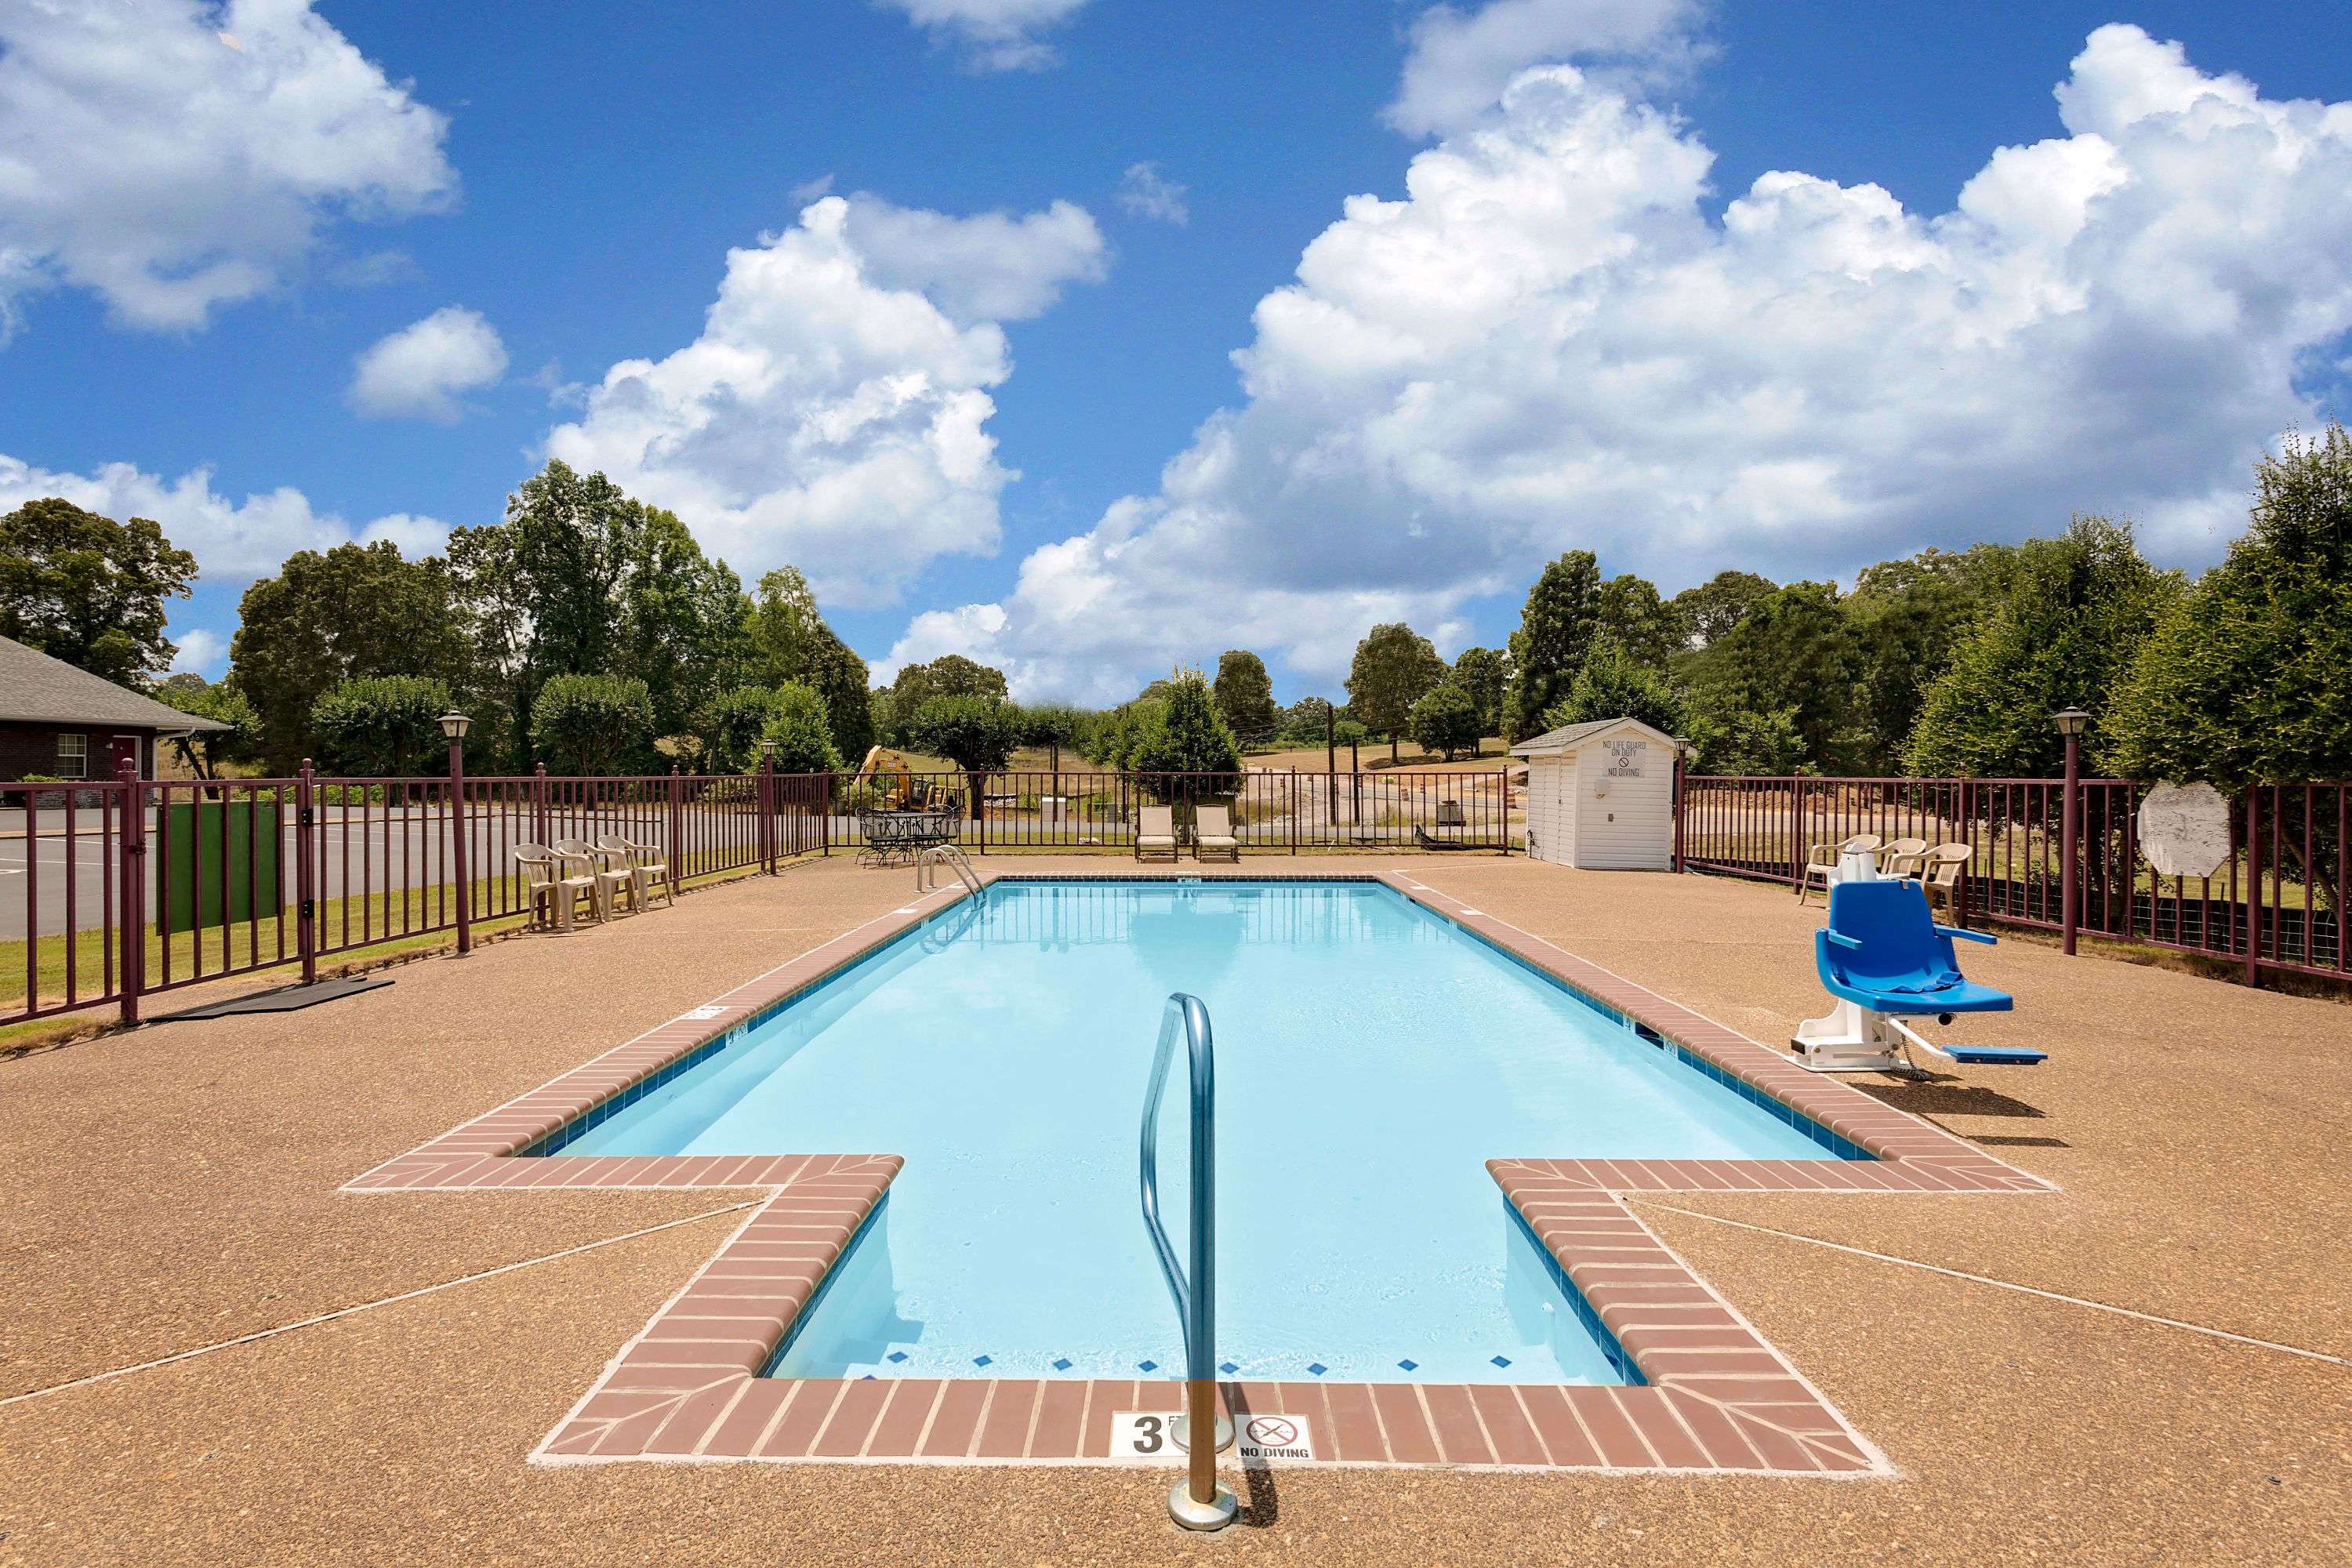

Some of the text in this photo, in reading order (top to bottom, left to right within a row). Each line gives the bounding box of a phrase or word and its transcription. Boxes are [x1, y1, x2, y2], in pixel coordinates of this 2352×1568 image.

[1602, 740, 1611, 749] NO
[1626, 741, 1646, 750] GUARD
[1611, 748, 1636, 757] ON DUTY
[1608, 768, 1639, 777] NO DIVING
[1133, 1416, 1163, 1454] 3
[1240, 1447, 1309, 1458] NO DIVING
